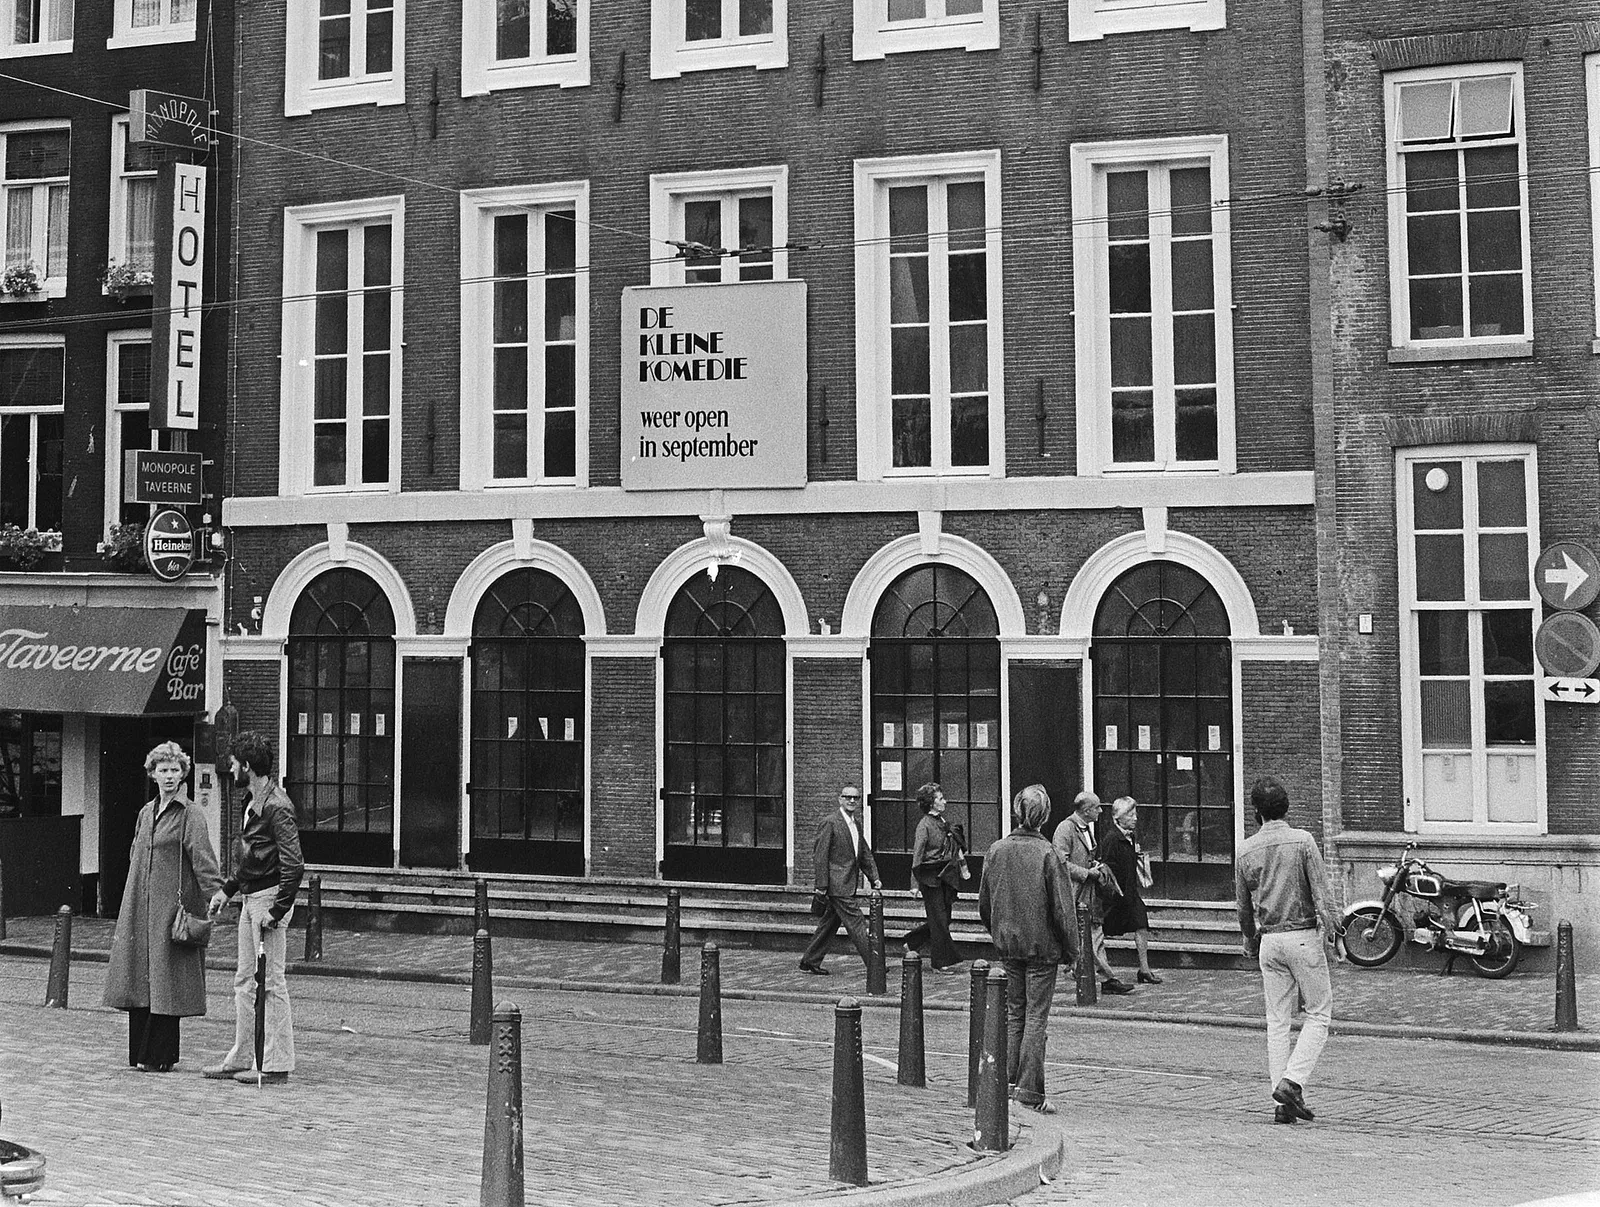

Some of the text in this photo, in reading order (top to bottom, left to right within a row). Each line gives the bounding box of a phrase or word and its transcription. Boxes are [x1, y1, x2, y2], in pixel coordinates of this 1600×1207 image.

[146, 99, 208, 144] MONOPOLE
[175, 174, 201, 419] HOTEL
[640, 306, 674, 329] DE
[640, 332, 724, 356] KLEINE
[640, 357, 748, 382] KOMEDIE
[641, 410, 729, 432] weer open
[640, 433, 758, 462] in september
[141, 461, 196, 475] MONOPOLE
[144, 481, 192, 494] TAVEERNE
[0, 628, 162, 673] Taveerne
[167, 644, 204, 677] Café
[167, 677, 204, 701] Bar
